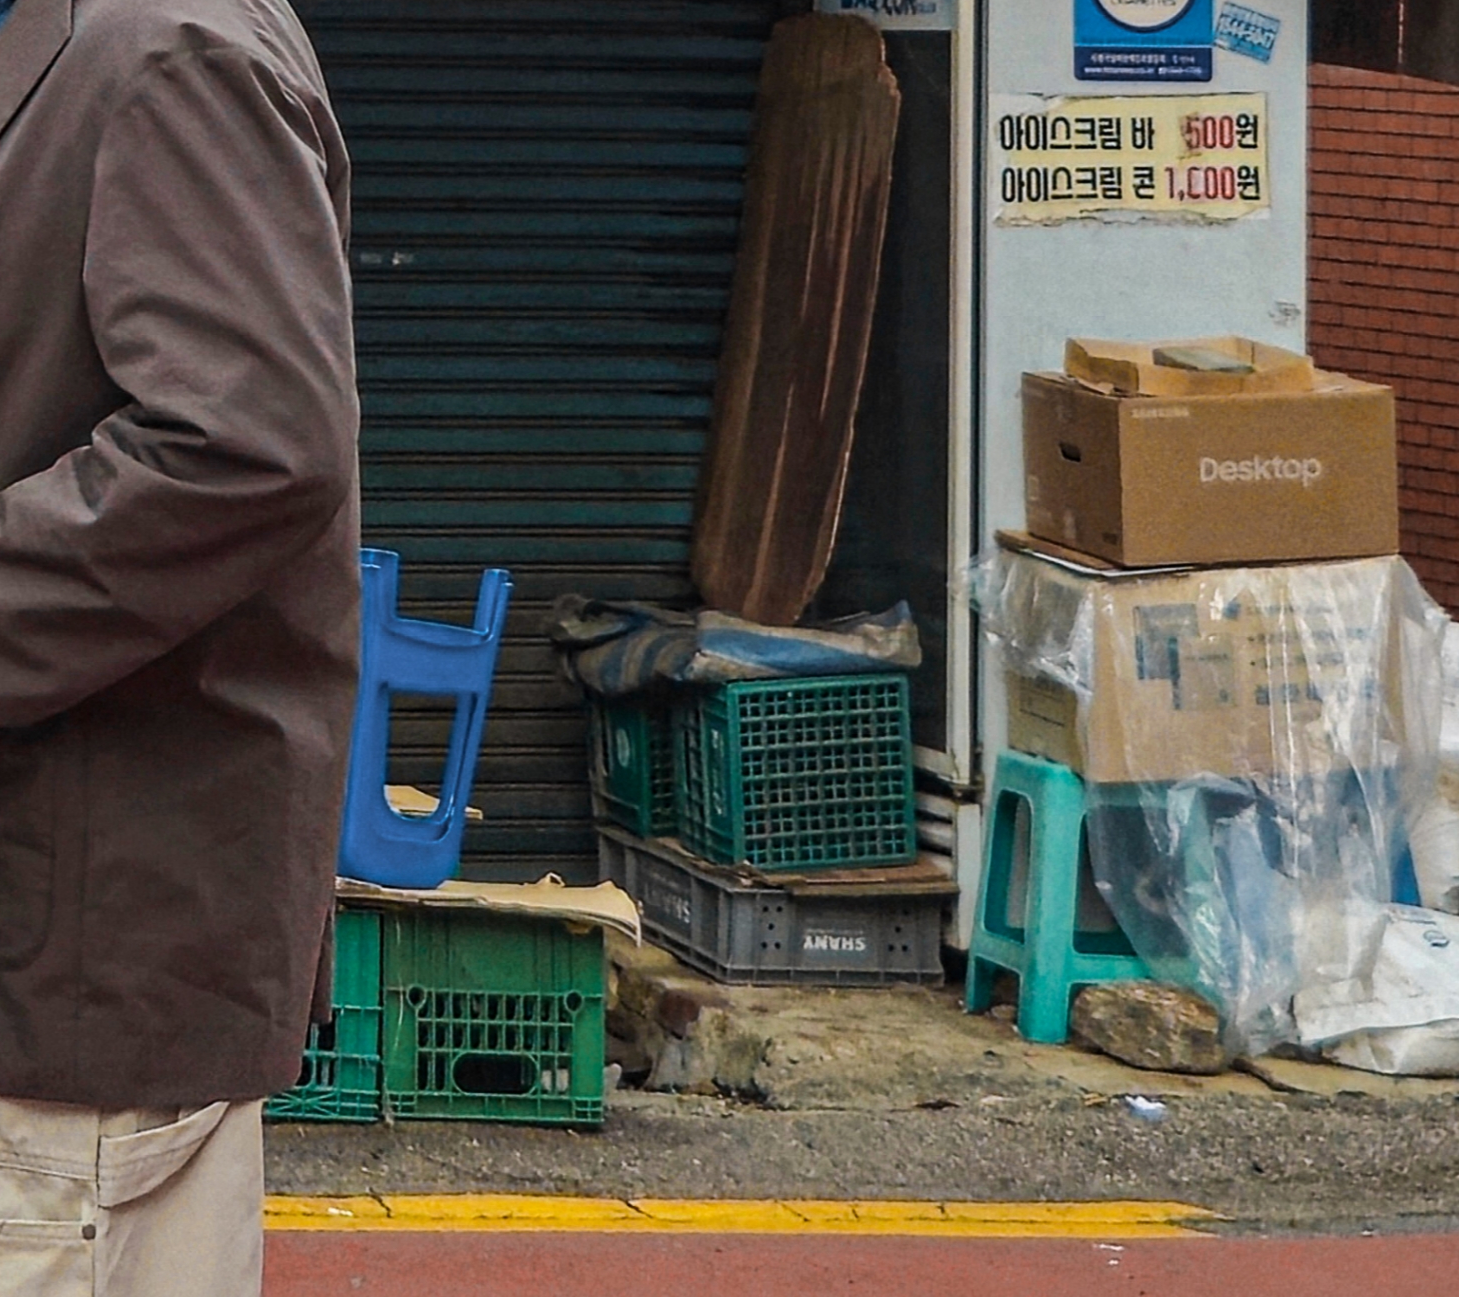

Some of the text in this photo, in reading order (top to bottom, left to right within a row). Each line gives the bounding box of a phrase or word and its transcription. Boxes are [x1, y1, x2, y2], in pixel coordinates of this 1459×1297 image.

[1000, 114, 1122, 151] 아이스크림
[1131, 116, 1155, 150] 바
[1001, 166, 1123, 203] 아이스크림
[1133, 166, 1155, 199] 콘
[1200, 455, 1323, 488] Desktop
